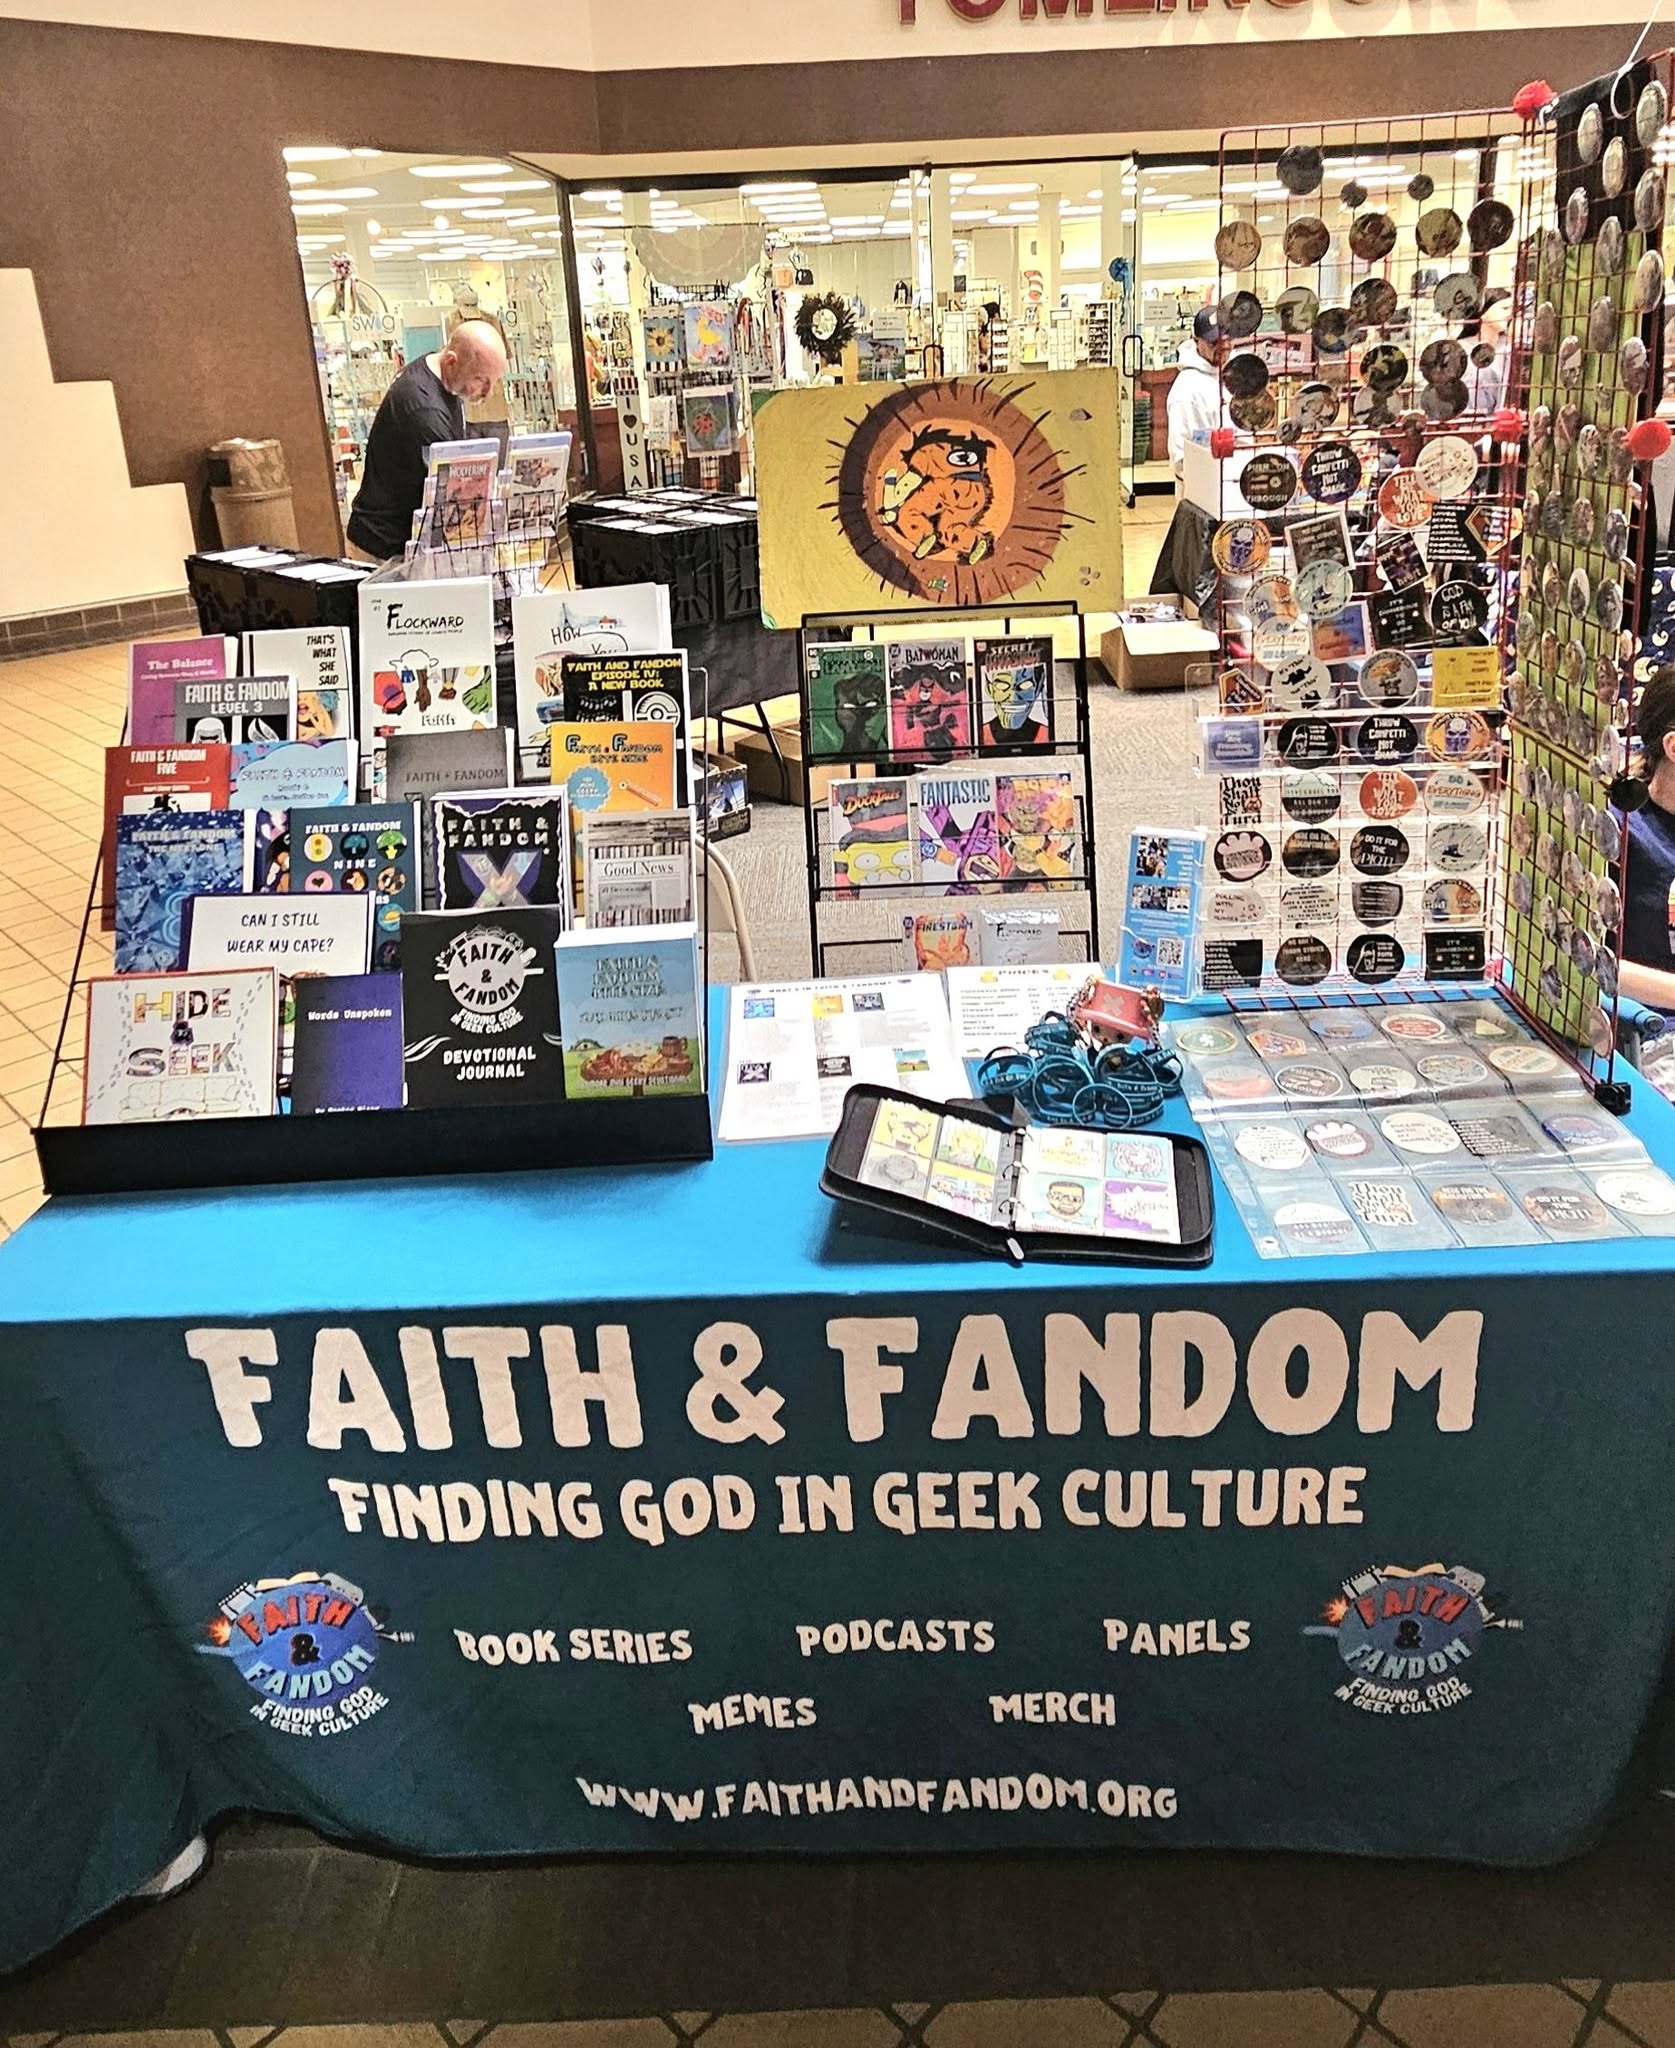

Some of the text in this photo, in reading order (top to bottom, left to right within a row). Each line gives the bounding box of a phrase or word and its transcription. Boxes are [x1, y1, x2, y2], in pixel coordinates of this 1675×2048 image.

[306, 634, 335, 646] THAT'S
[551, 626, 581, 646] How
[312, 647, 337, 659] WHAT
[147, 657, 214, 670] The Balance
[319, 661, 336, 672] SHE
[567, 657, 681, 672] FAITH AND FANDOM
[318, 674, 339, 686] SAID
[591, 670, 640, 681] EPISODE
[601, 680, 626, 690] NEW
[630, 678, 664, 688] BOOK
[185, 680, 290, 704] FAITH & FANDOM
[211, 701, 263, 715] LEVEL 3
[157, 762, 178, 775] FIVE
[406, 772, 440, 783] FAITH
[454, 768, 505, 782] FANDOM
[920, 778, 991, 807] FANTASTIC
[305, 823, 339, 834] FAITH
[351, 820, 402, 832] FANDOM
[447, 816, 549, 833] FAITH &
[448, 832, 549, 848] FANDOM
[1365, 834, 1399, 847] DO IT FOR
[333, 858, 377, 870] NINE
[604, 861, 674, 877] Good News
[241, 912, 319, 928] CAN I STILL
[227, 937, 334, 953] WEAR MY CAPE?
[457, 942, 515, 968] FAITH
[481, 968, 492, 983] &
[454, 977, 520, 1006] FANDOM
[133, 988, 232, 1025] HIDE
[308, 1007, 392, 1021] Words Unspoken
[459, 1006, 517, 1025] FINDING GOD
[460, 1020, 484, 1034] GEEK
[485, 1011, 524, 1034] CULTURE
[126, 1041, 239, 1077] SEEK
[443, 1046, 537, 1065] DEVOTIONAL
[456, 1063, 525, 1081] JOURNAL
[184, 1307, 1484, 1452] FAITH & FANDOM
[327, 1466, 1368, 1547] FINDING GOD IN GEEK CULTURE
[1354, 1583, 1470, 1629] FAITH
[236, 1592, 355, 1646] FAITH
[453, 1617, 1251, 1666] BOOK SERIES PODCASTS PANELS
[1395, 1618, 1424, 1650] &
[290, 1632, 322, 1667] &
[1342, 1637, 1474, 1681] FANDOM
[243, 1644, 376, 1700] FANDOM
[1333, 1682, 1473, 1715] IN GEEK CULTURE
[1347, 1676, 1462, 1704] FINDING GOD
[249, 1692, 391, 1738] IN GEEK CULTURE
[261, 1686, 374, 1725] FINDING GOD
[688, 1692, 1117, 1735] MEMES MERCH
[575, 1773, 1178, 1823] WWW.FAITHANDFANDOM.ORG
